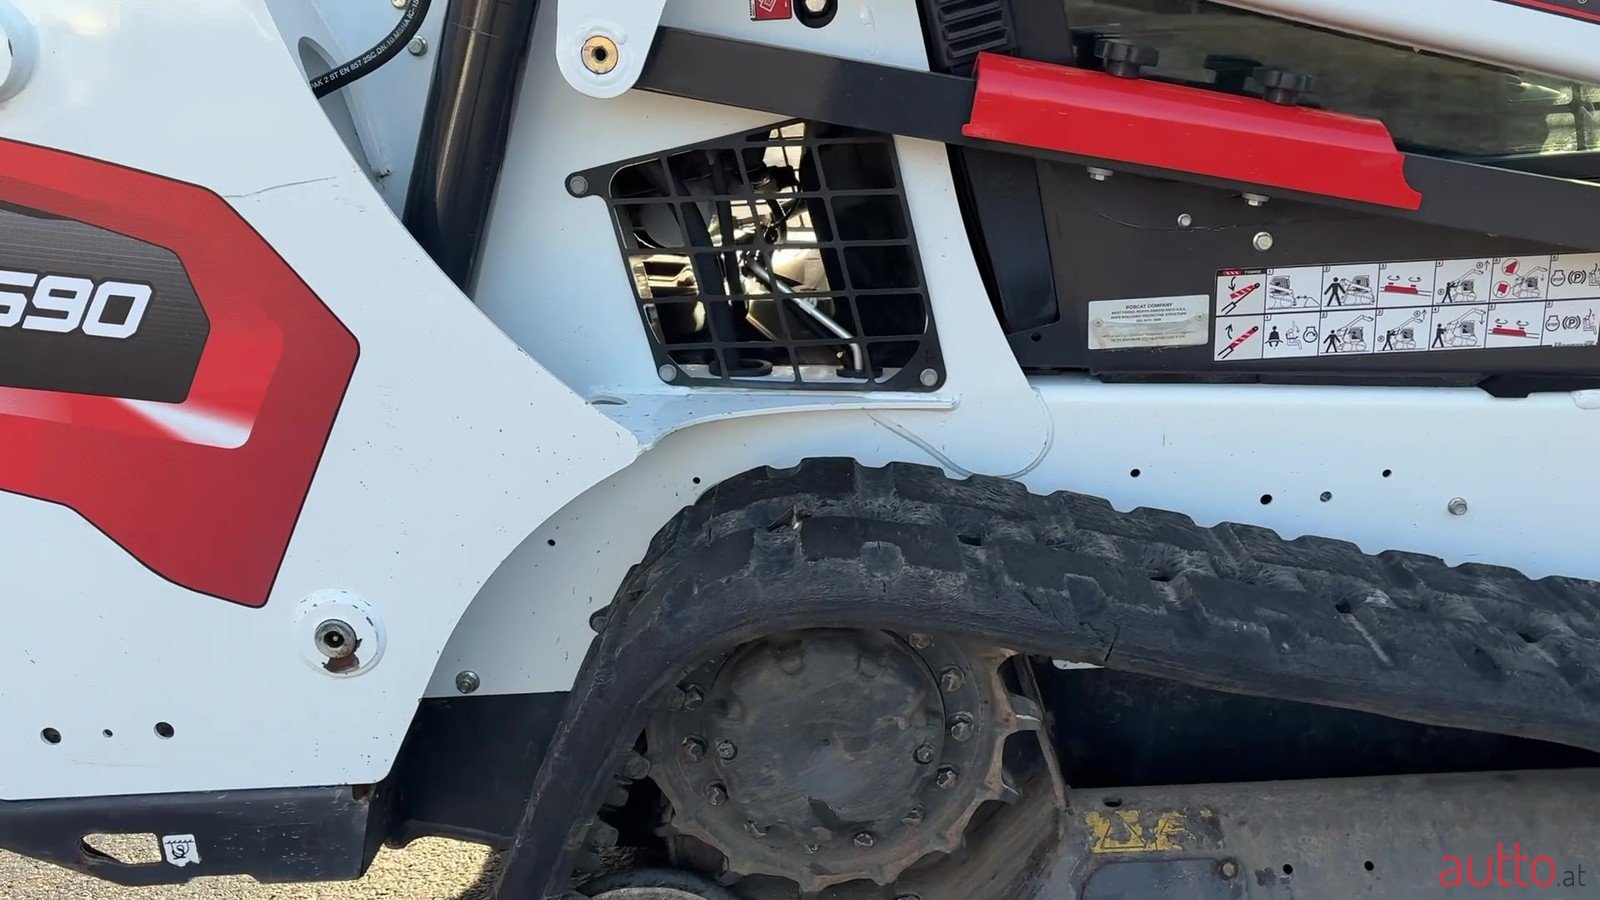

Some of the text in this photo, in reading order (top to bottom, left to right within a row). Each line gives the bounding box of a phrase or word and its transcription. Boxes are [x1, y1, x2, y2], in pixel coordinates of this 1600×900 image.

[323, 76, 330, 84] 2
[329, 71, 339, 81] ST
[339, 66, 351, 77] EN
[350, 59, 362, 71] 857
[363, 51, 377, 65] 2SC
[376, 43, 387, 55] DN
[386, 36, 395, 46] 10
[393, 18, 411, 39] MSHA
